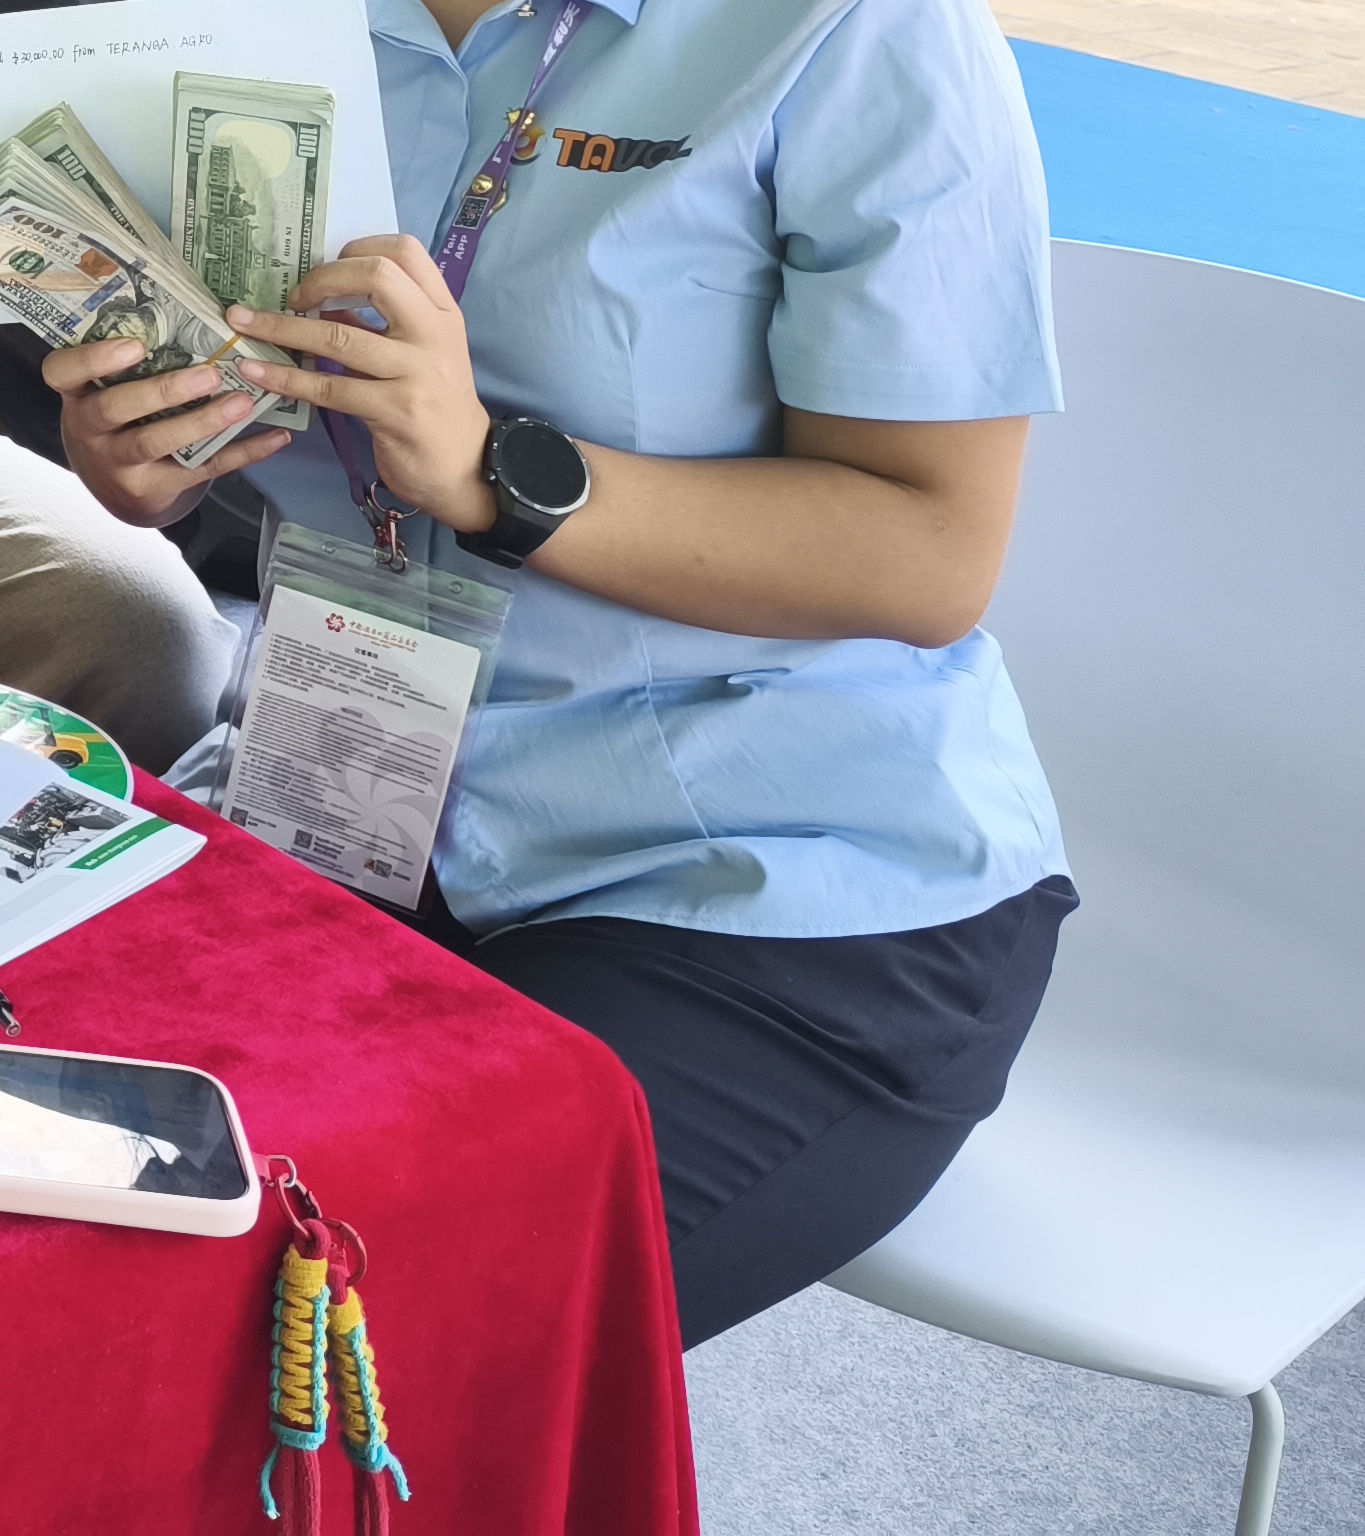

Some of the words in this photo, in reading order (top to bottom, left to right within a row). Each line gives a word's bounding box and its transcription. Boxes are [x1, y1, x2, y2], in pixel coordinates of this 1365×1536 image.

[72, 44, 96, 67] from
[187, 107, 206, 154] 100
[297, 123, 320, 158] 100
[56, 144, 87, 181] 100
[12, 213, 67, 240] 100
[443, 233, 458, 255] Fair
[455, 234, 468, 260] APP
